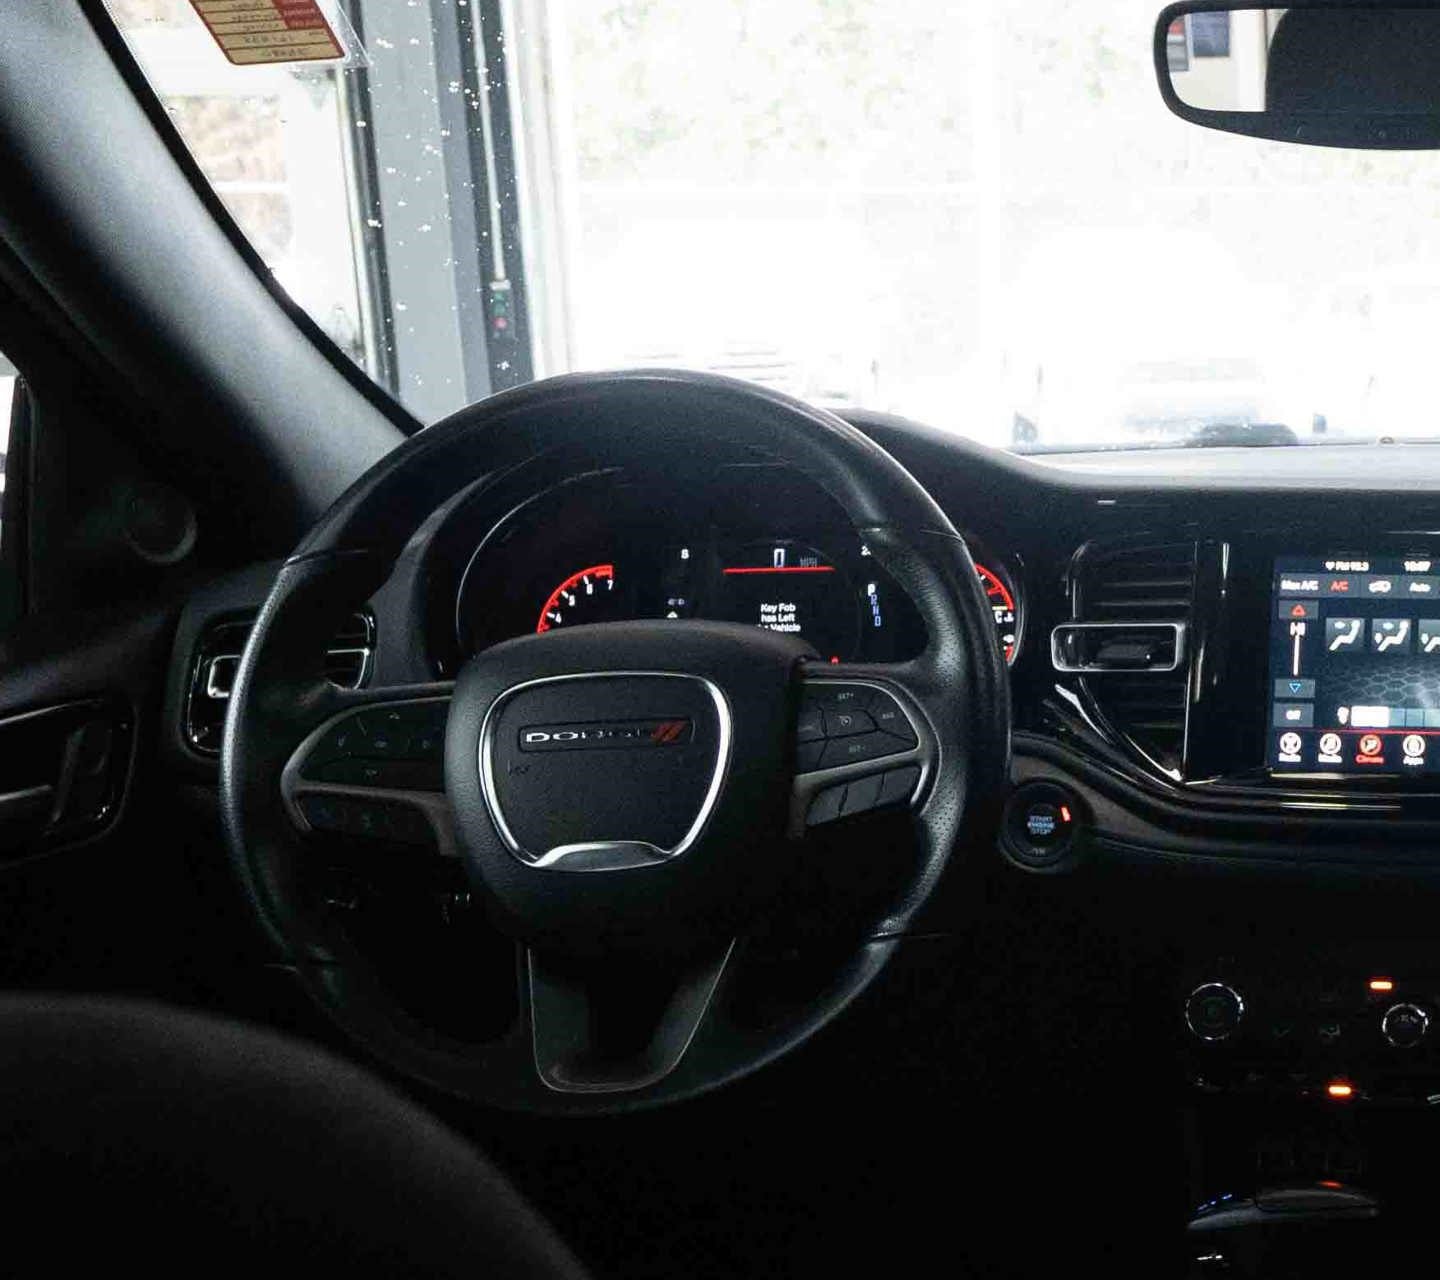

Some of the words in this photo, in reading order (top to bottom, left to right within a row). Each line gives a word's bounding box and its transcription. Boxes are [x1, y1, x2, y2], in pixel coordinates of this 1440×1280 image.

[867, 583, 876, 596] P
[1330, 580, 1349, 591] A/C
[760, 603, 777, 614] Key
[779, 603, 796, 613] Fob
[760, 614, 776, 623] has
[778, 613, 795, 623] Left
